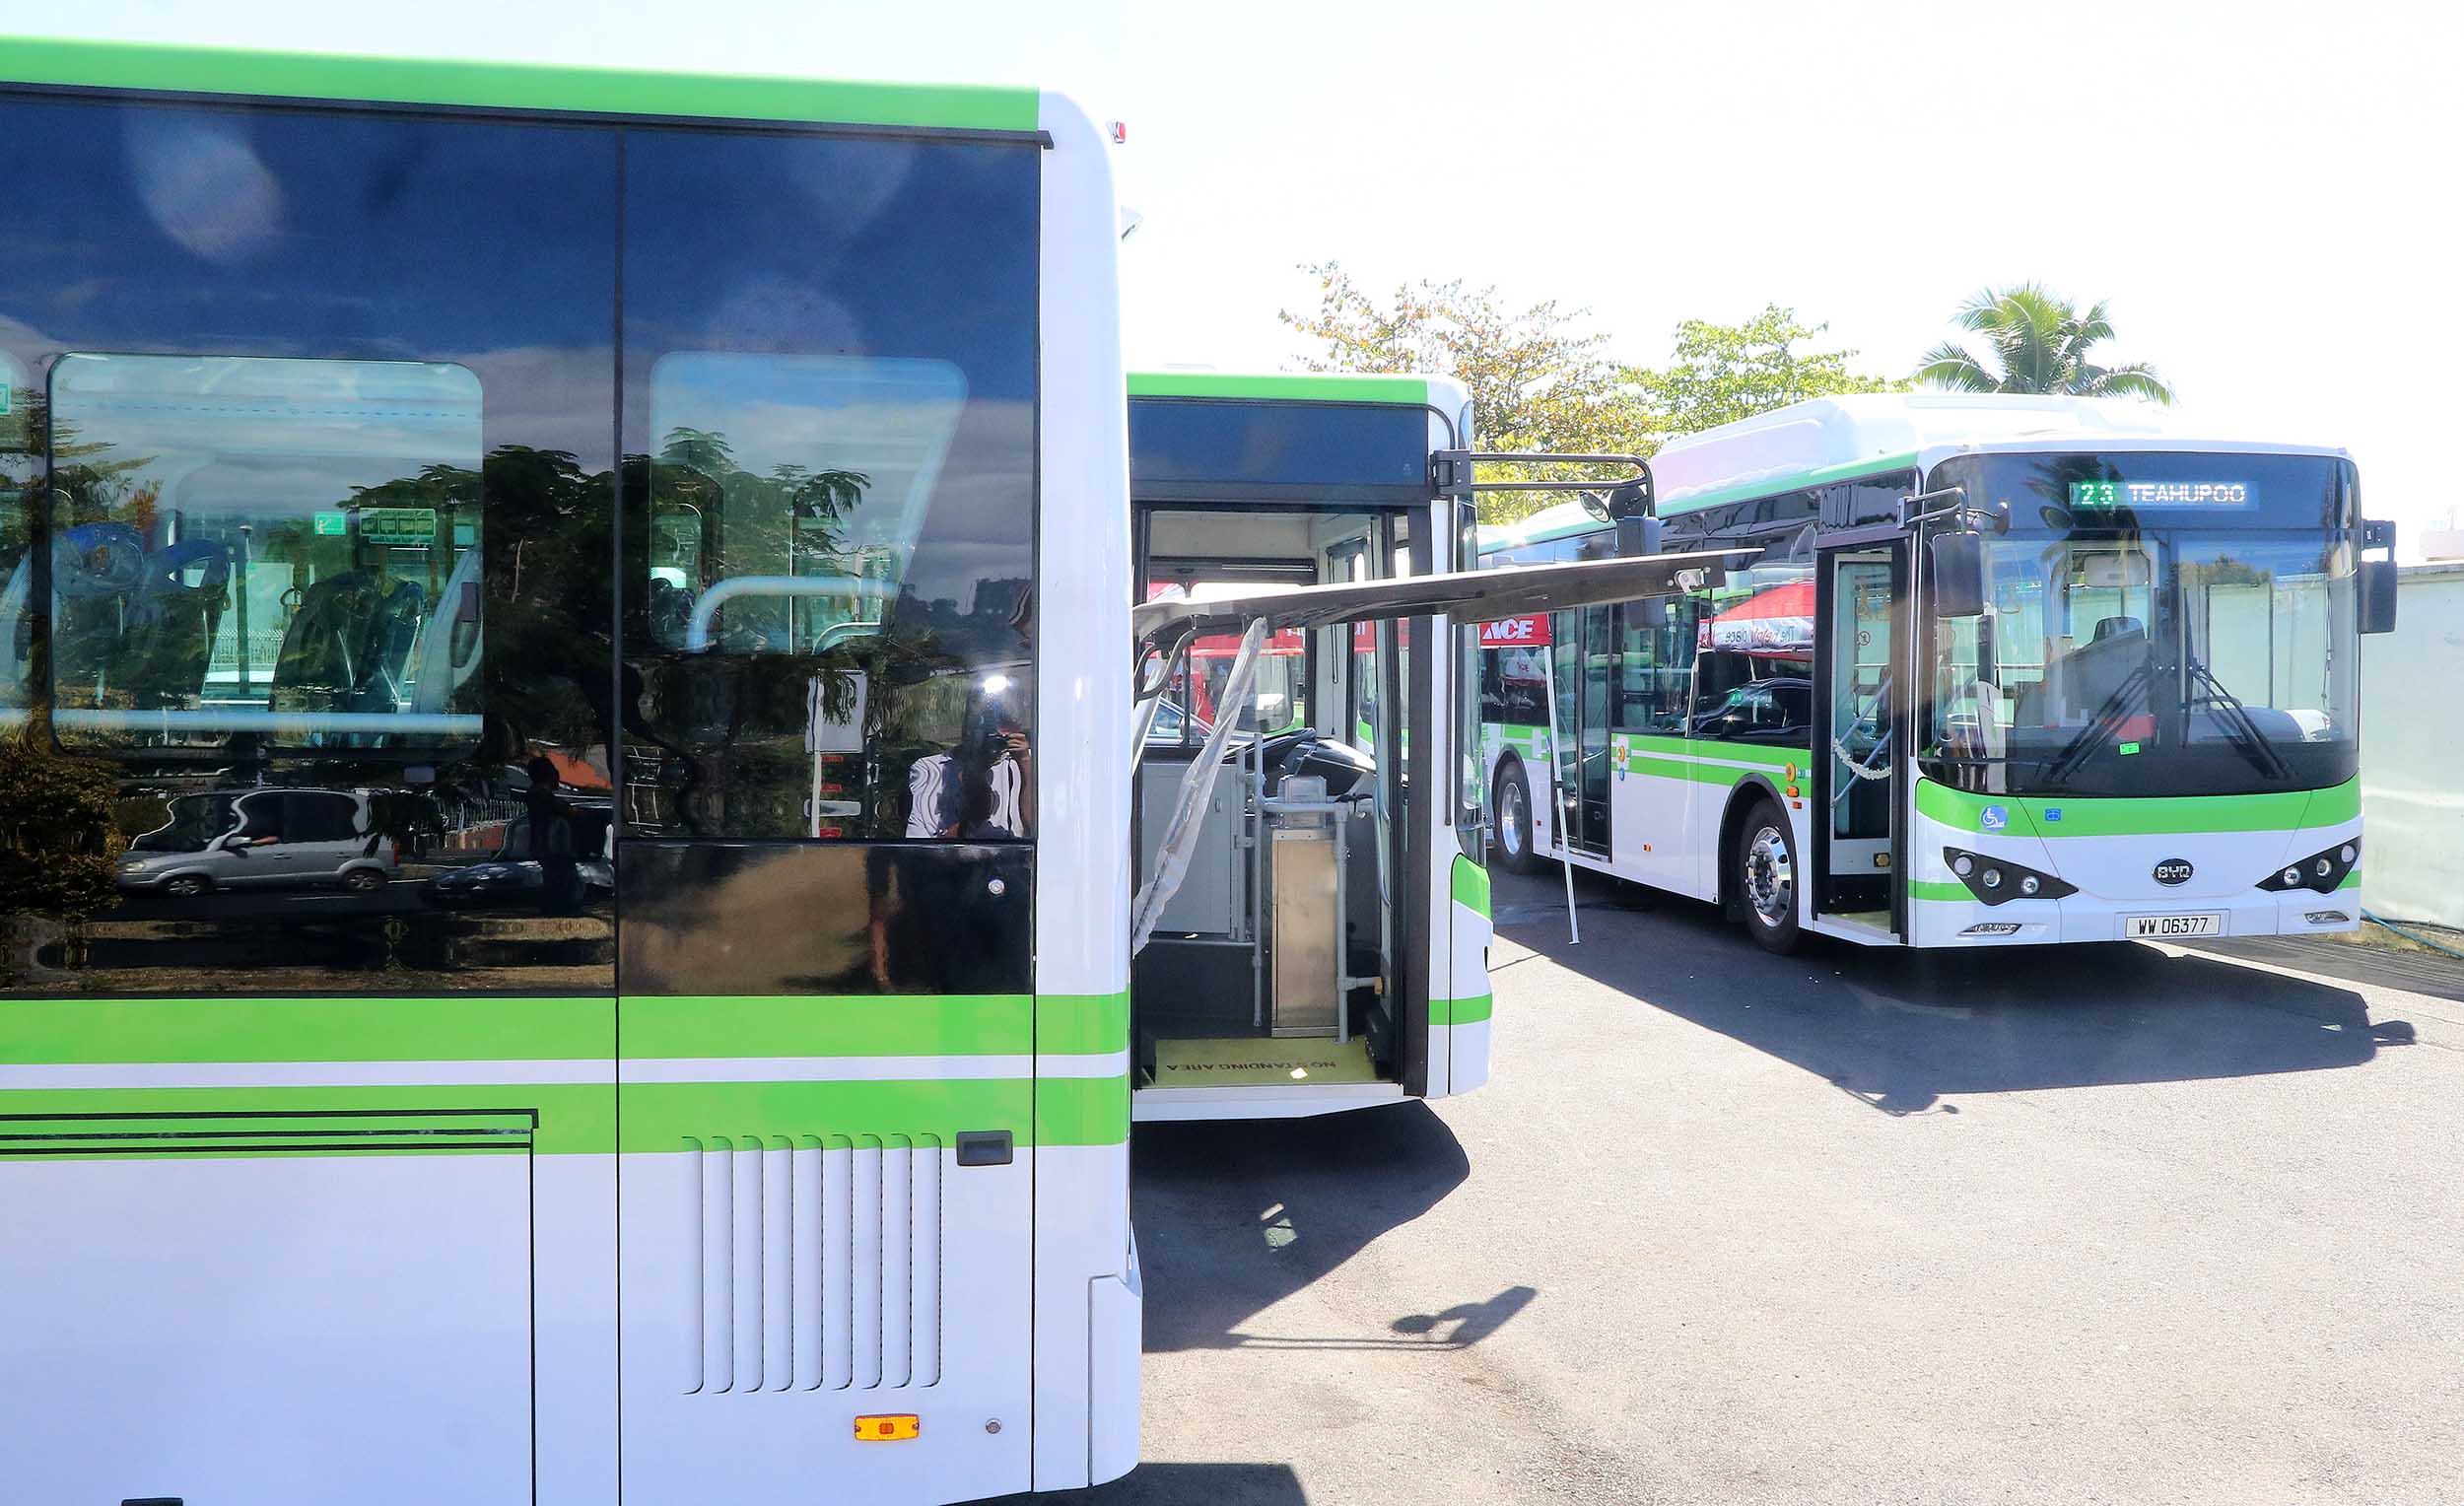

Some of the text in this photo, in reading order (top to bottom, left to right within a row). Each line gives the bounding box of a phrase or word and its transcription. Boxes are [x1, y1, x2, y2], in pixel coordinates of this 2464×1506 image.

[2080, 483, 2246, 506] 23 TEAHUPOO
[1481, 618, 1535, 640] ACE
[2156, 864, 2190, 879] BYD
[2138, 917, 2209, 935] WW 06377
[1310, 1061, 1337, 1069] NO
